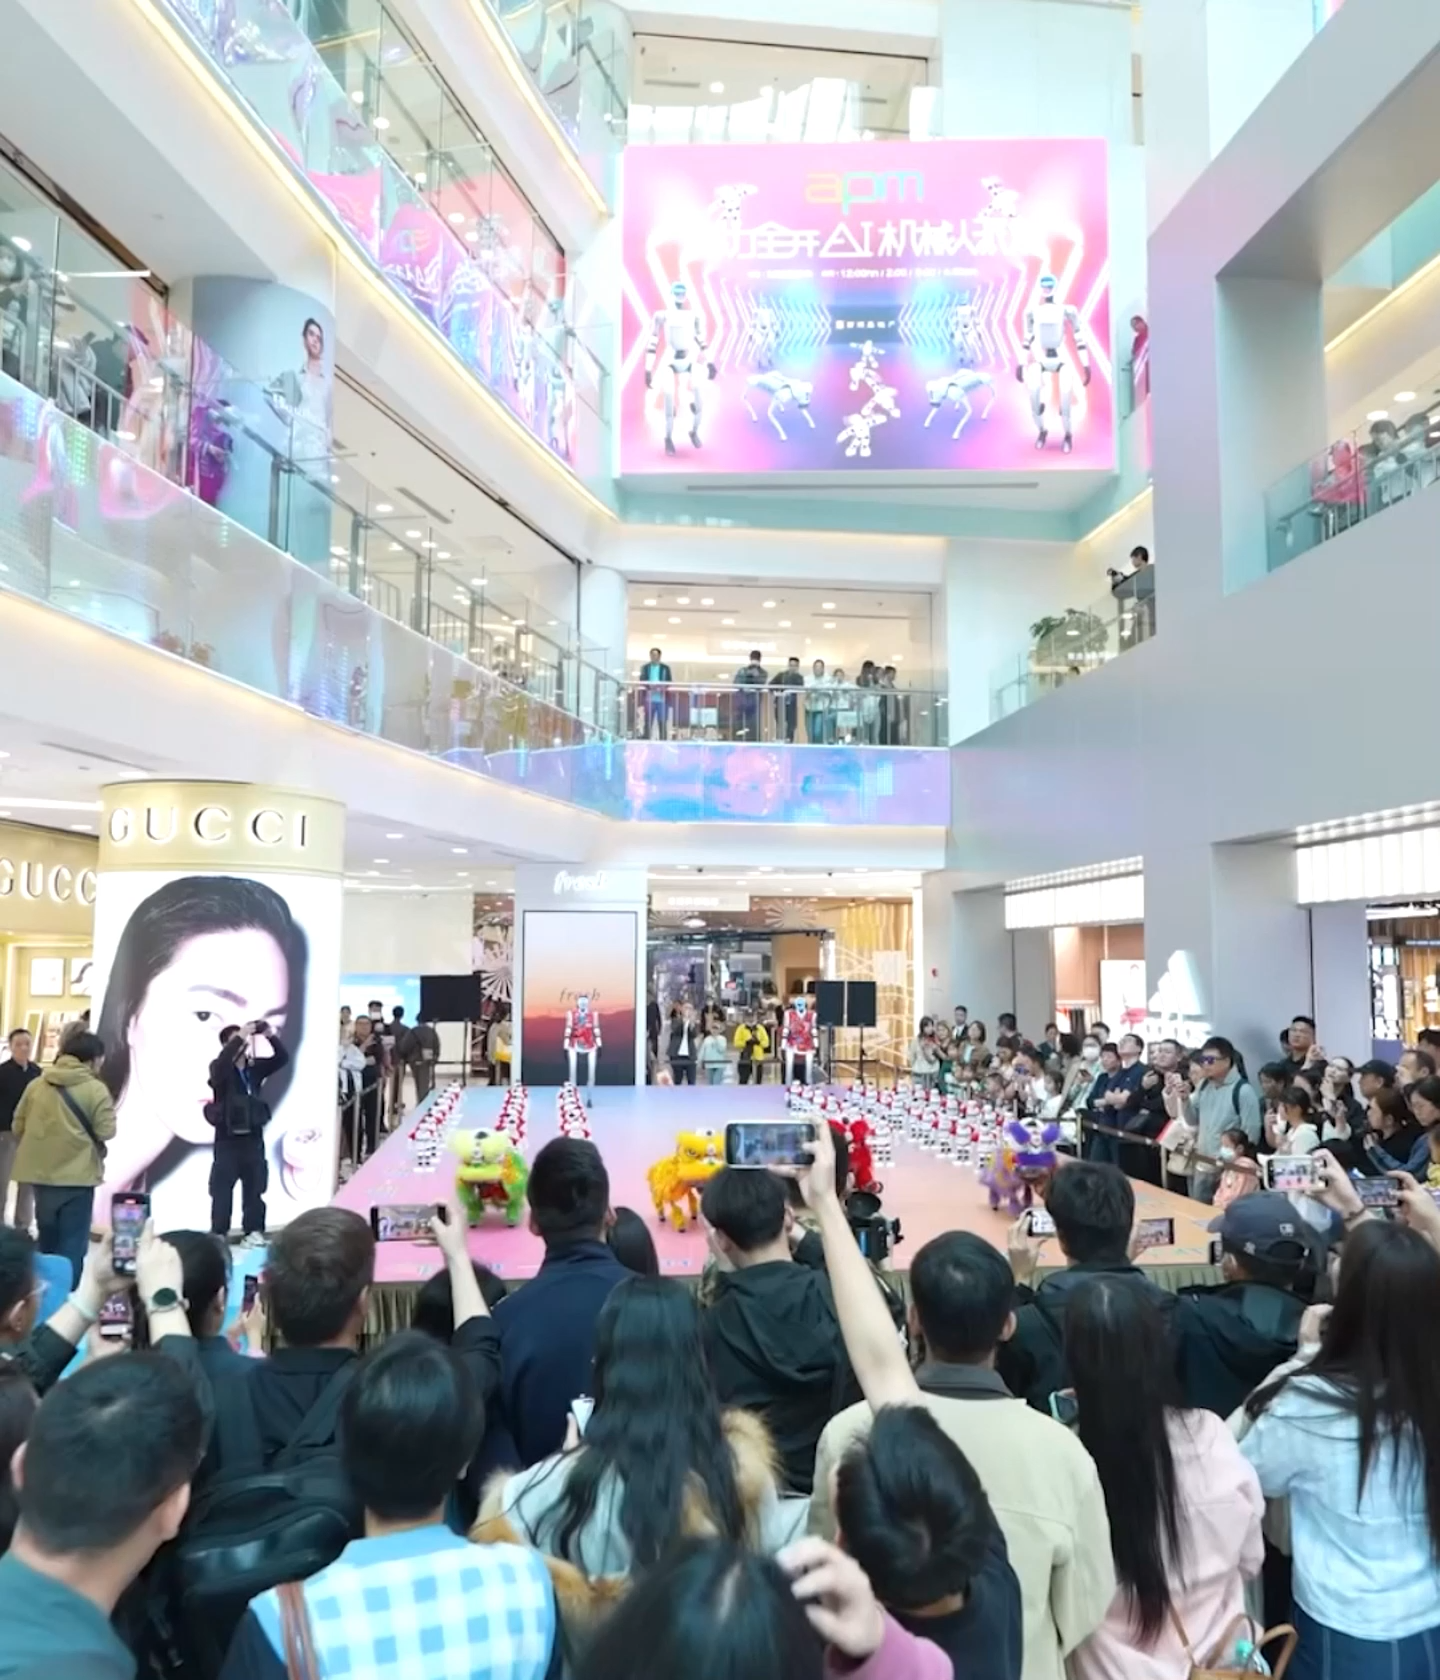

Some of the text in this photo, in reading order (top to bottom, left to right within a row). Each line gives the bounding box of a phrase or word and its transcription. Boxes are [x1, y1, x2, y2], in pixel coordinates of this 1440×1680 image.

[804, 171, 924, 216] apm
[108, 806, 306, 848] GUCCI
[0, 856, 97, 906] GUCC
[559, 987, 601, 1003] frh
